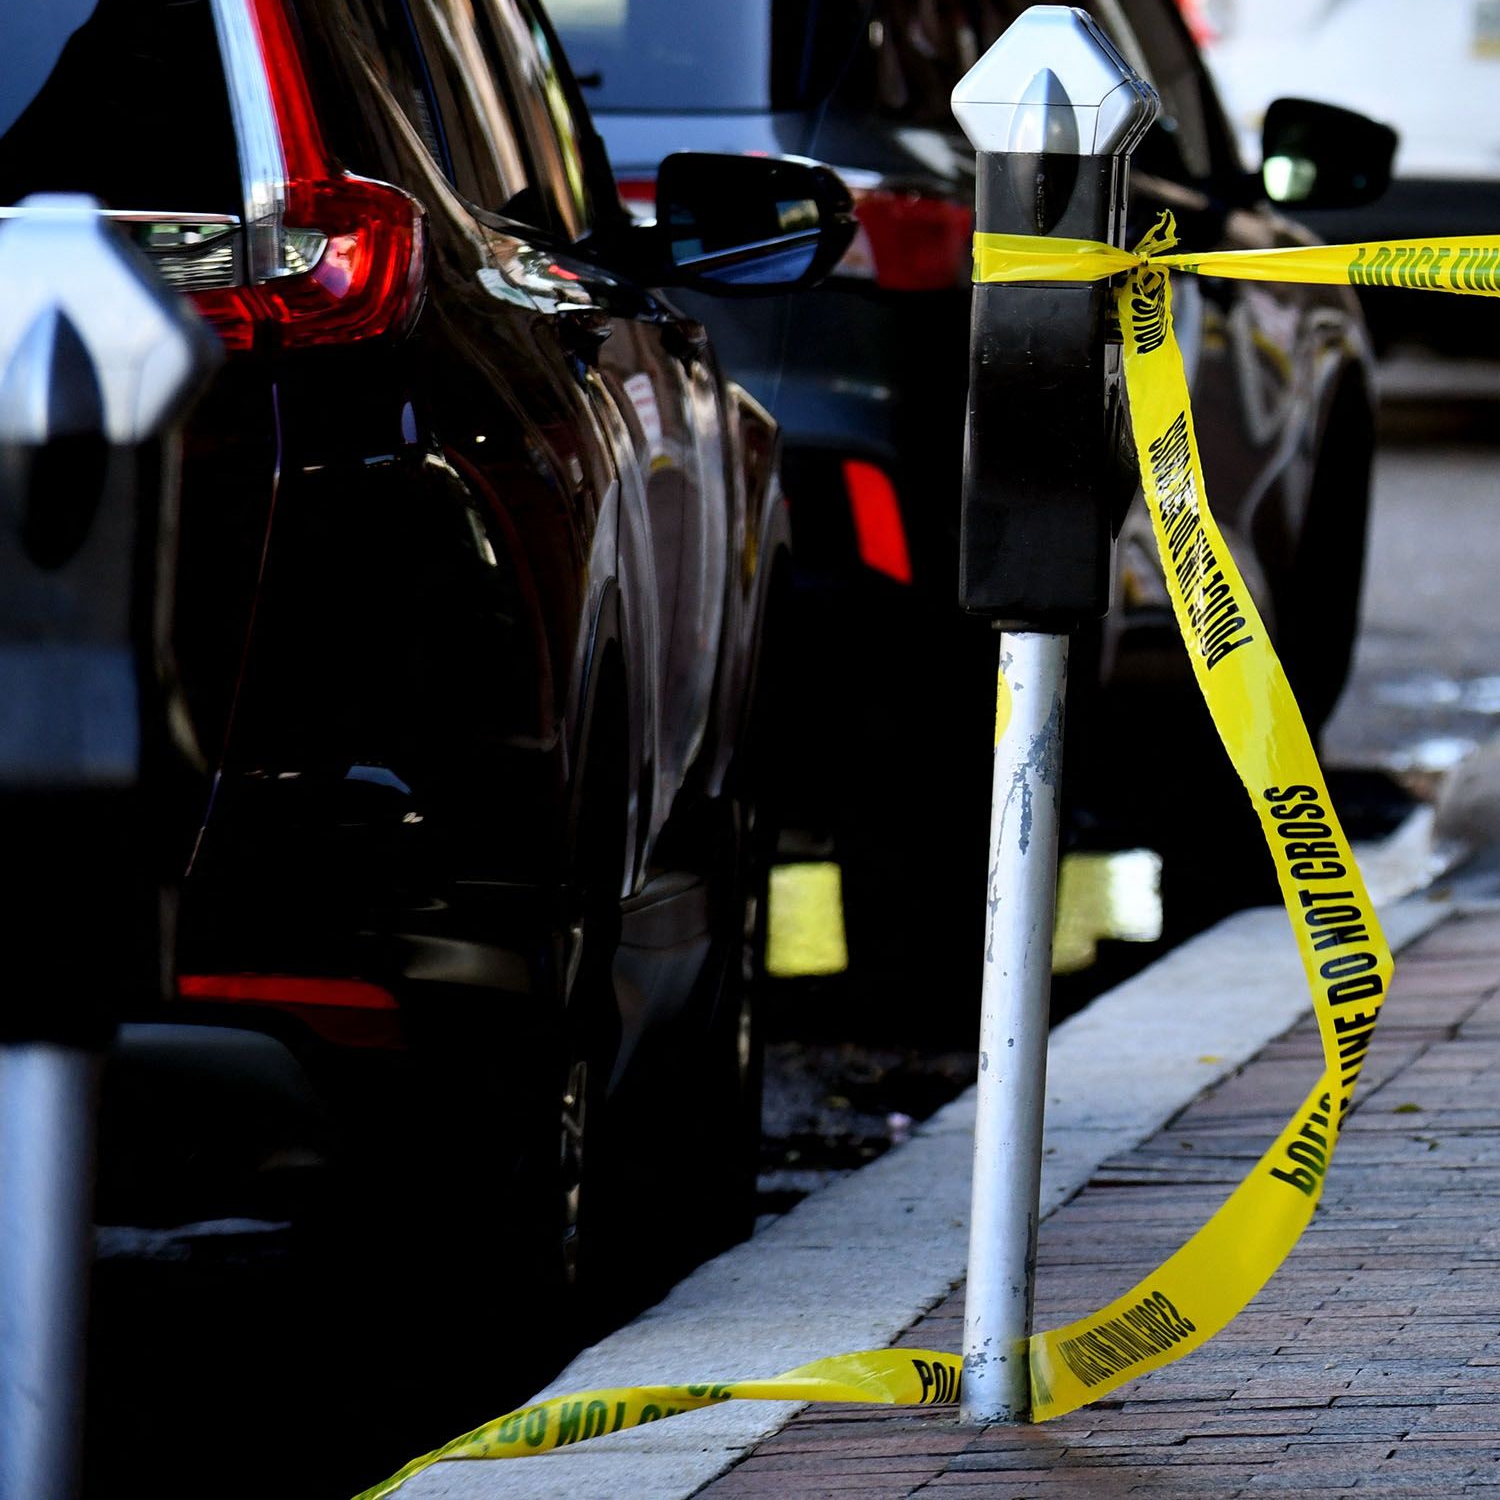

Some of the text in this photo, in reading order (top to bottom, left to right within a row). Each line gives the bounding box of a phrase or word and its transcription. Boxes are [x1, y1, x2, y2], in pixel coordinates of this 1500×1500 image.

[1263, 785, 1347, 880] CROSS
[1298, 889, 1371, 952] NOT
[1320, 952, 1383, 1007] DO
